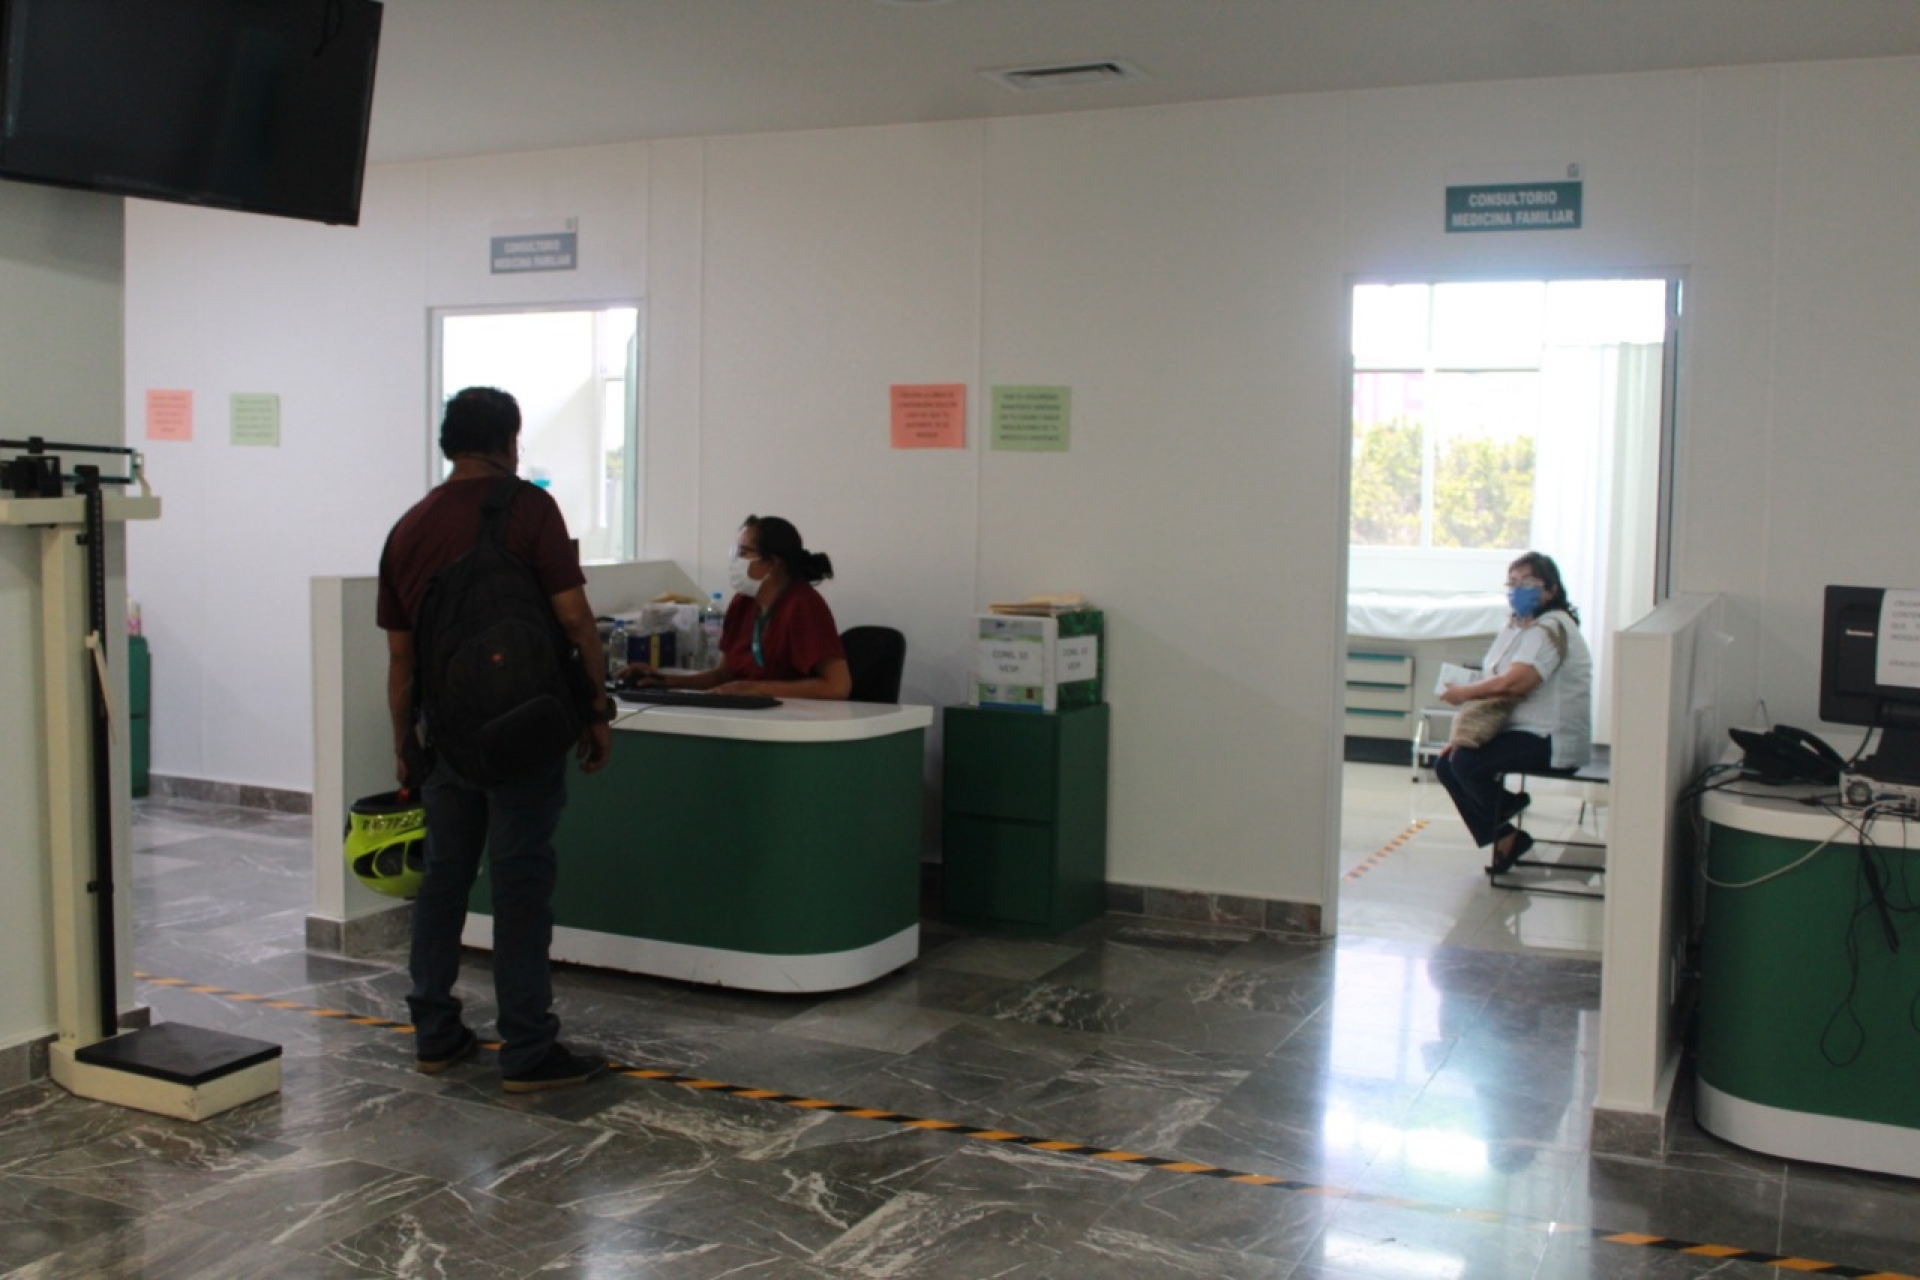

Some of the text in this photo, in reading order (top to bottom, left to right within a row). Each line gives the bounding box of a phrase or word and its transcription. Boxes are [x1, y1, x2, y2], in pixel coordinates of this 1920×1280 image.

[1468, 190, 1558, 207] CONSULTORIO
[1451, 209, 1576, 227] MEDICINA FAMILIAR
